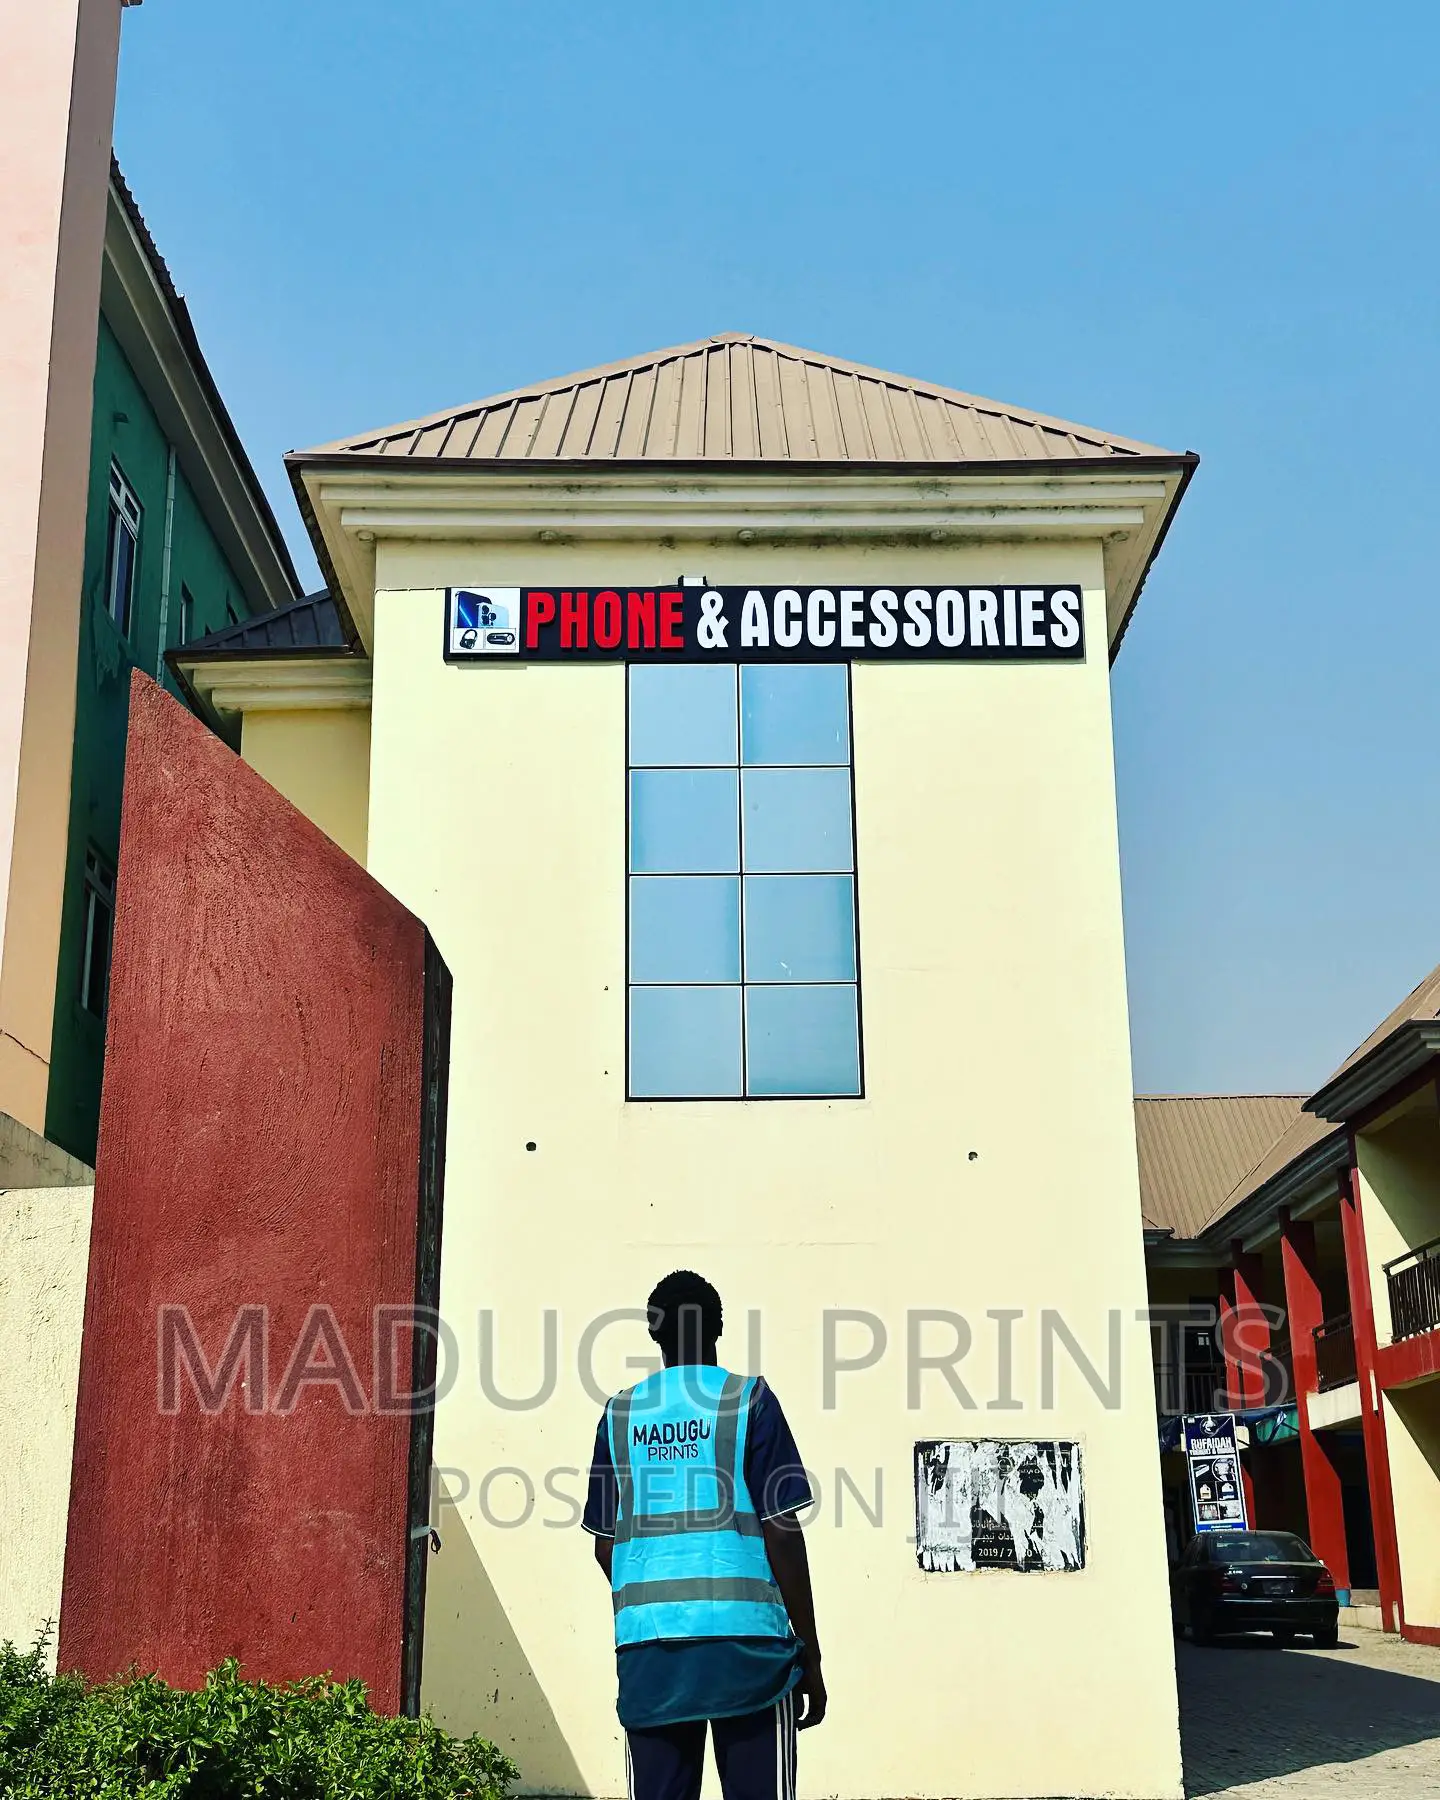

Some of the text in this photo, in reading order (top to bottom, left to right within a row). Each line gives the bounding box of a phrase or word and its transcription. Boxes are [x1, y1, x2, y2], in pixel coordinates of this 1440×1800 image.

[525, 588, 1082, 650] PHONE & ACCESSORIES
[633, 1418, 711, 1446] MADUGU
[648, 1443, 699, 1461] PRINTS
[1190, 1436, 1232, 1451] RUFAIDAH
[978, 1548, 998, 1557] 2019
